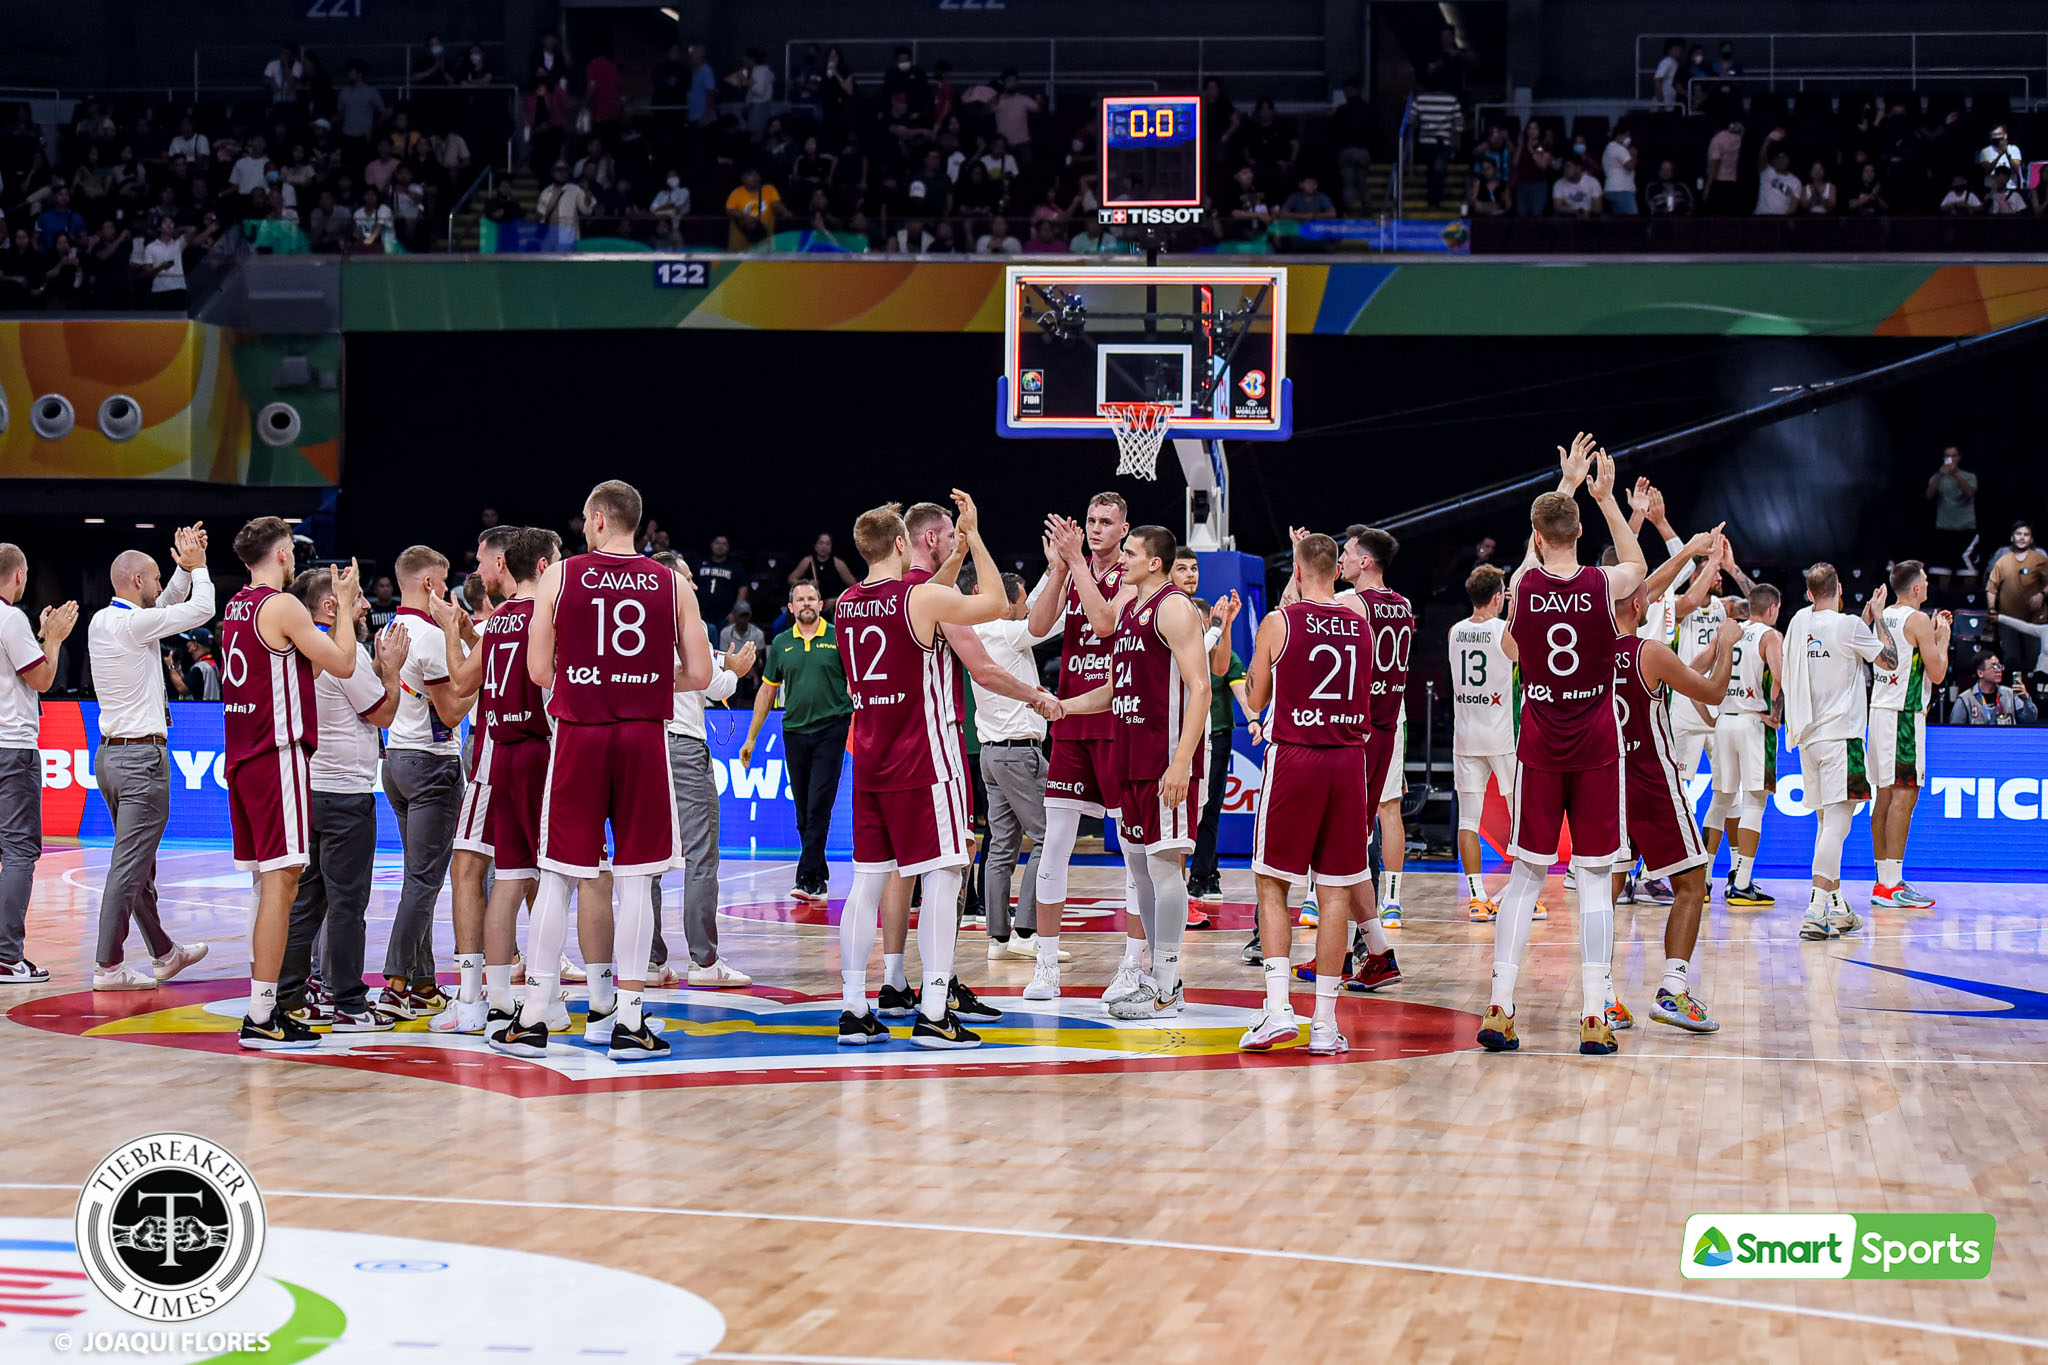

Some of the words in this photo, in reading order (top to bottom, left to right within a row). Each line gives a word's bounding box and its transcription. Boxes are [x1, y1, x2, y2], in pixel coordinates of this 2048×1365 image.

[1130, 109, 1174, 138] 0.0
[1128, 208, 1204, 224] TISSOT
[658, 263, 704, 284] 122
[581, 567, 659, 591] ČAVARS
[1530, 591, 1592, 613] DĀVIS
[591, 597, 646, 657] 18
[1306, 613, 1360, 637] ŠĶĒLE
[1456, 631, 1491, 644] JOKUBAITIS
[1546, 622, 1580, 677] 8
[844, 624, 888, 682] 12
[483, 641, 520, 699] 47
[566, 665, 601, 685] tet
[1115, 661, 1133, 689] 24
[1308, 644, 1357, 701] 21
[1460, 649, 1487, 687] 13
[1455, 693, 1490, 704] etsafe
[1291, 707, 1325, 727] tet
